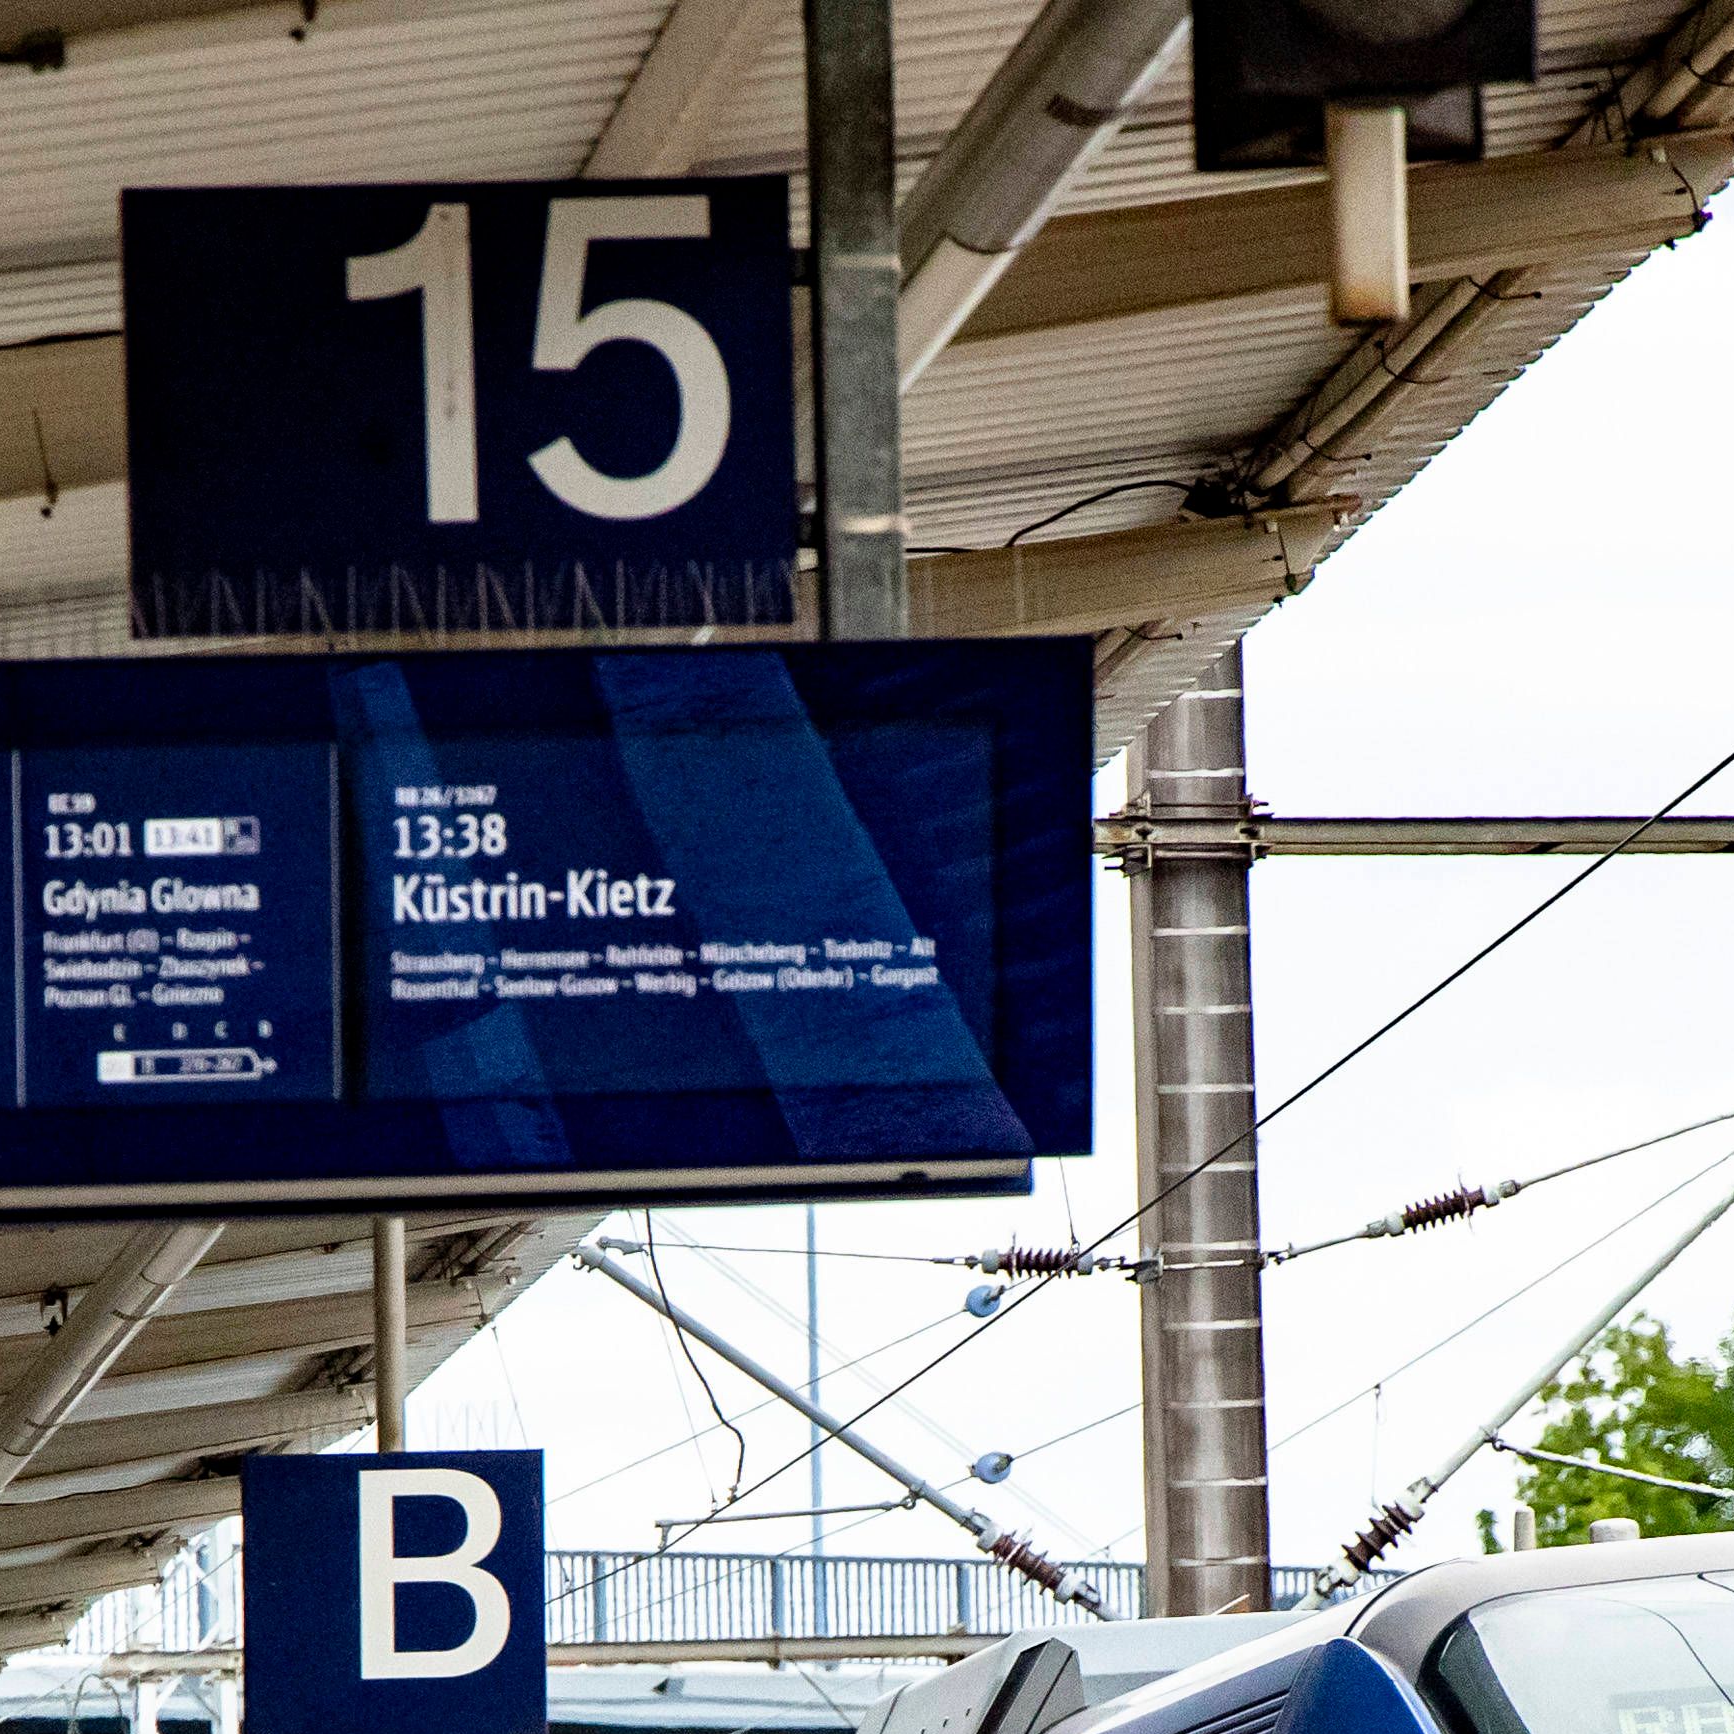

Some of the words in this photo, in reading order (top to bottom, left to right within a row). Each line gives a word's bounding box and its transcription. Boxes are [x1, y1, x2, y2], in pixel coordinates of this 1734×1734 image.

[345, 194, 731, 523] 15
[45, 822, 132, 858] 13:01
[393, 813, 507, 860] 13:38
[43, 880, 146, 921] Gdynia
[393, 869, 675, 923] Küstrin-Kietz
[359, 1468, 511, 1680] B
